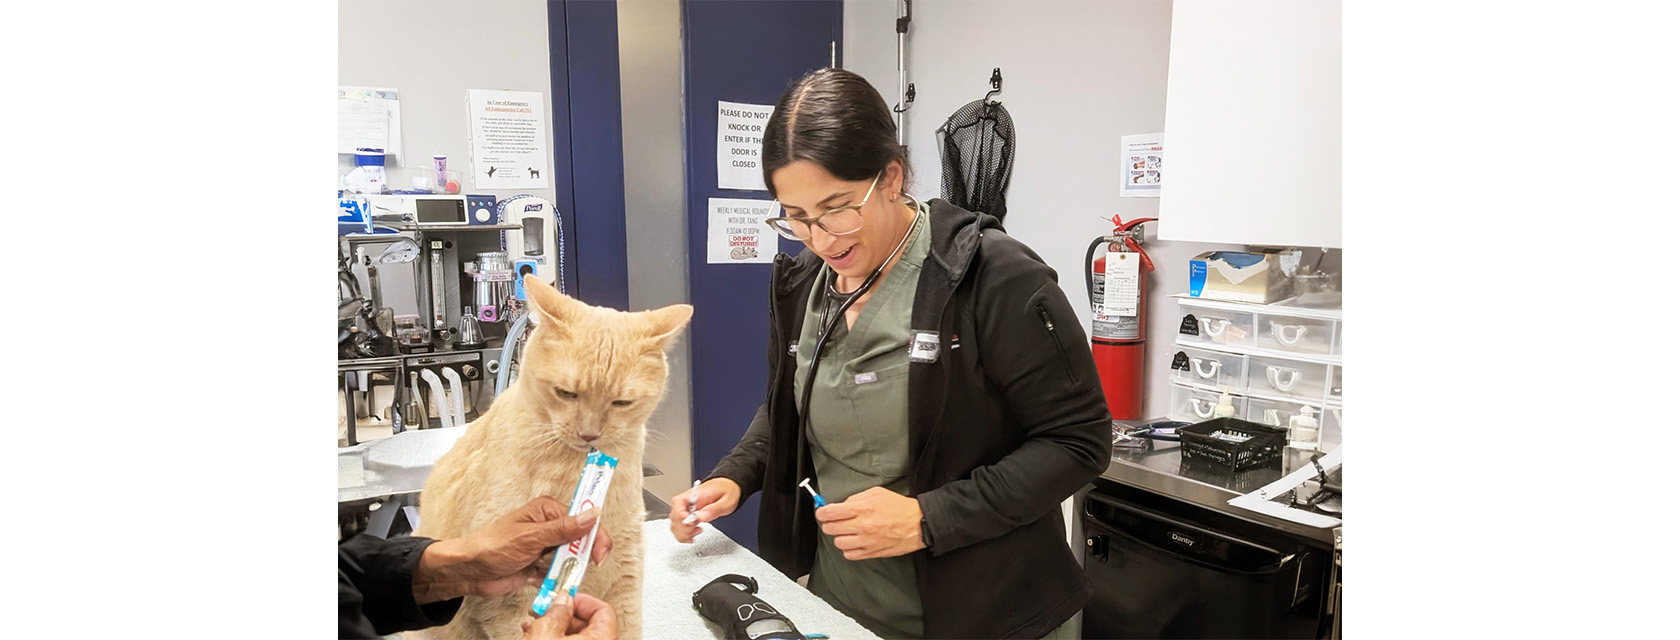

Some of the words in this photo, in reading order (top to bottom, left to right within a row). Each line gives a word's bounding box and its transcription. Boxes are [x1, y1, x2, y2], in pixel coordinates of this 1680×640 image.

[720, 109, 740, 117] PLEASE
[742, 111, 752, 119] DO
[728, 123, 750, 131] KNOCK
[724, 135, 743, 143] ENTER
[731, 148, 750, 156] DOOR
[732, 160, 756, 168] CLOSED
[717, 206, 732, 214] WEEKLY
[1171, 533, 1194, 547] Danby
